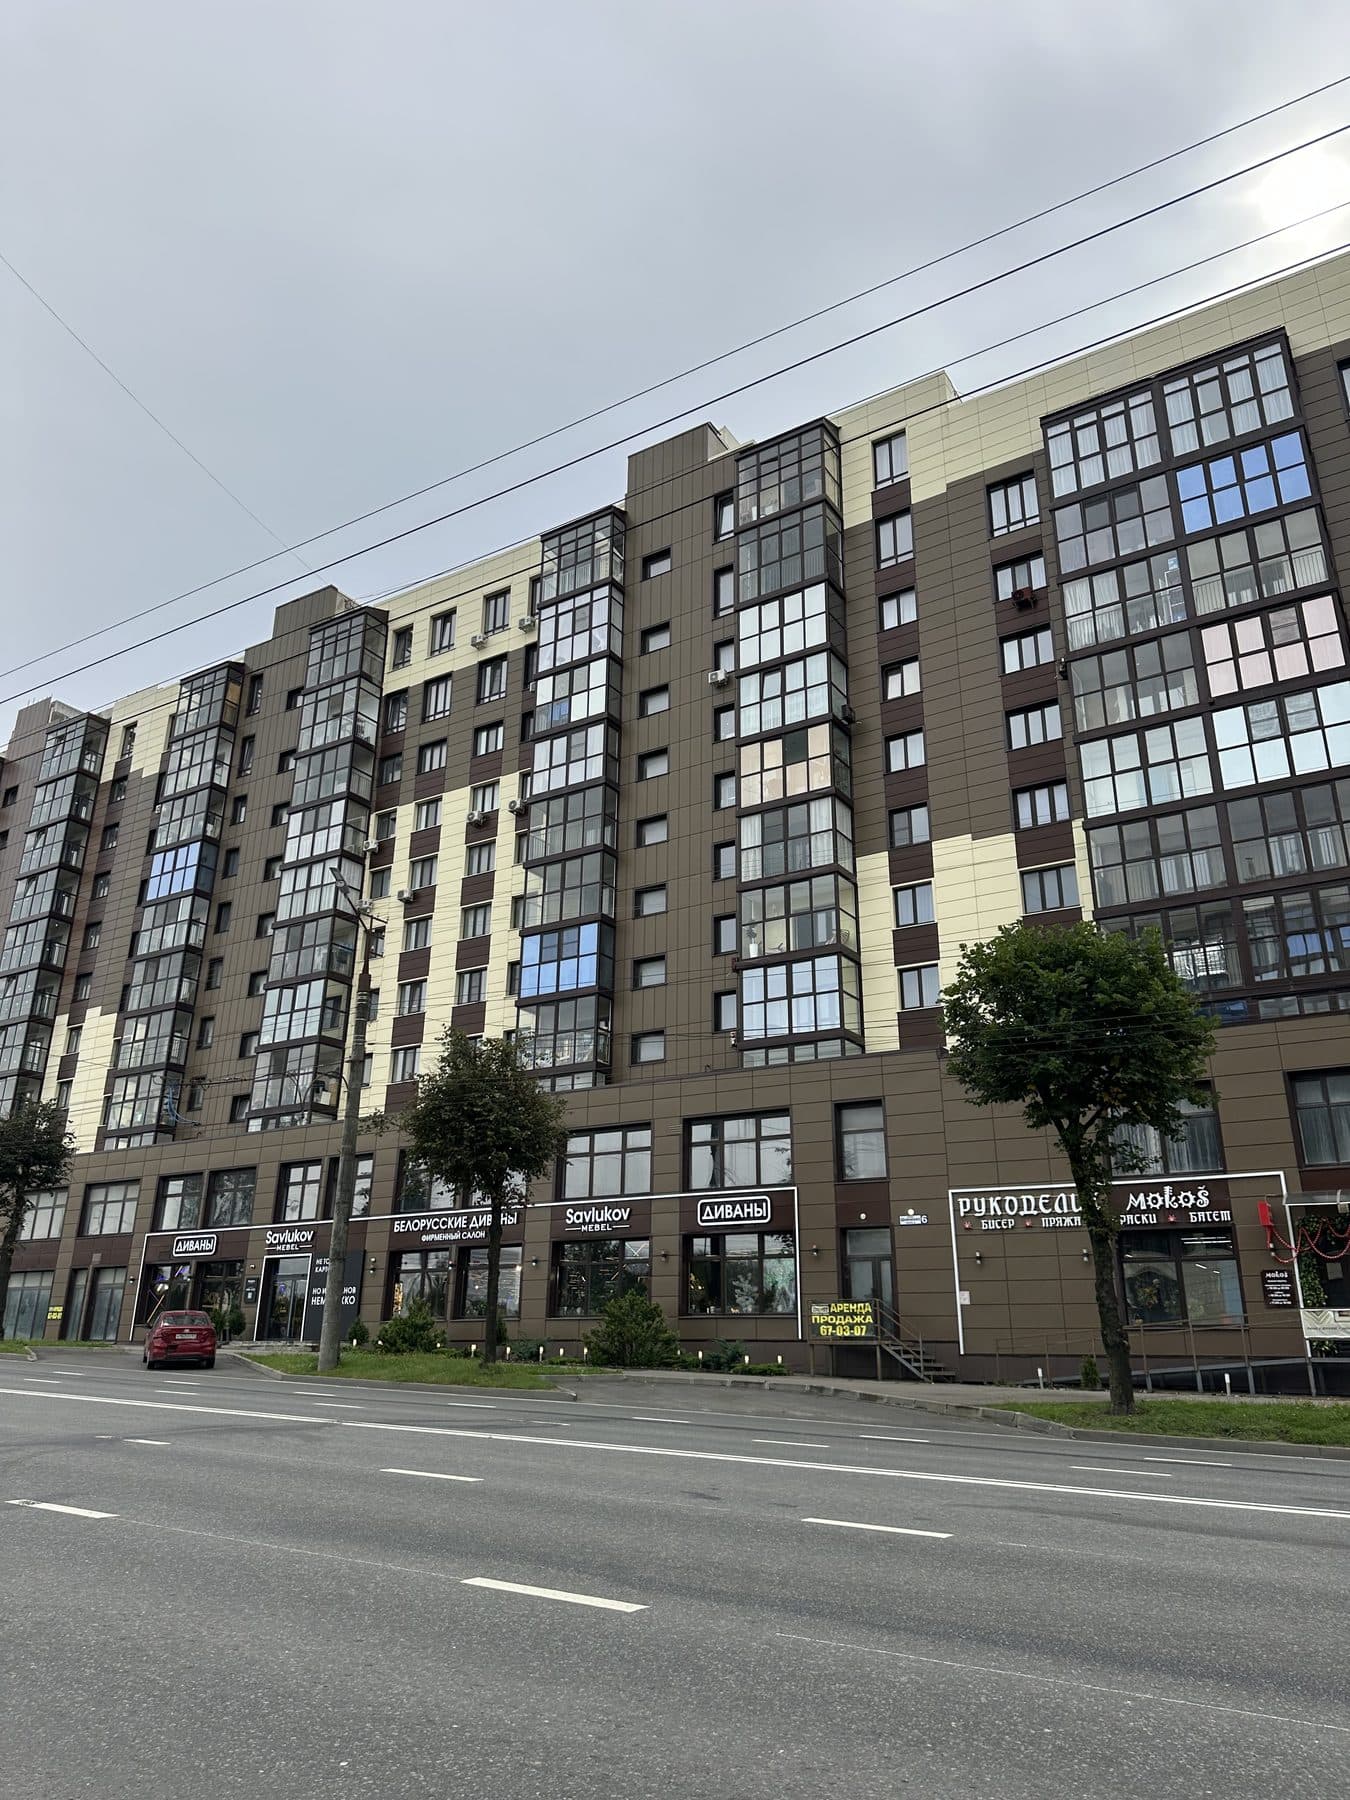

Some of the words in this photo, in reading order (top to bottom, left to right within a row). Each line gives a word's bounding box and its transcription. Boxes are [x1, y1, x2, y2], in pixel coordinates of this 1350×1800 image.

[565, 1206, 630, 1224] Savlukov
[701, 1202, 767, 1220] ДИВАНЫ
[394, 1216, 468, 1232] БЕЛОРУССКИЕ
[469, 1212, 518, 1229] ДИВНЫ
[921, 1215, 928, 1224] 6
[981, 1219, 1015, 1230] БИСЕР
[1119, 1213, 1157, 1225] РАСКИ
[1189, 1210, 1232, 1223] БАГЕТ
[581, 1224, 612, 1232] MEBEL
[265, 1229, 314, 1244] Savlukov
[421, 1230, 461, 1241] ФИРМЕННЫЙ
[462, 1230, 486, 1239] САЛОН
[175, 1238, 214, 1252] ДИВАНЫ
[830, 1302, 872, 1314] АРЕНДА
[811, 1315, 873, 1325] ПРОДАЖА
[820, 1325, 867, 1336] 67-03-07
